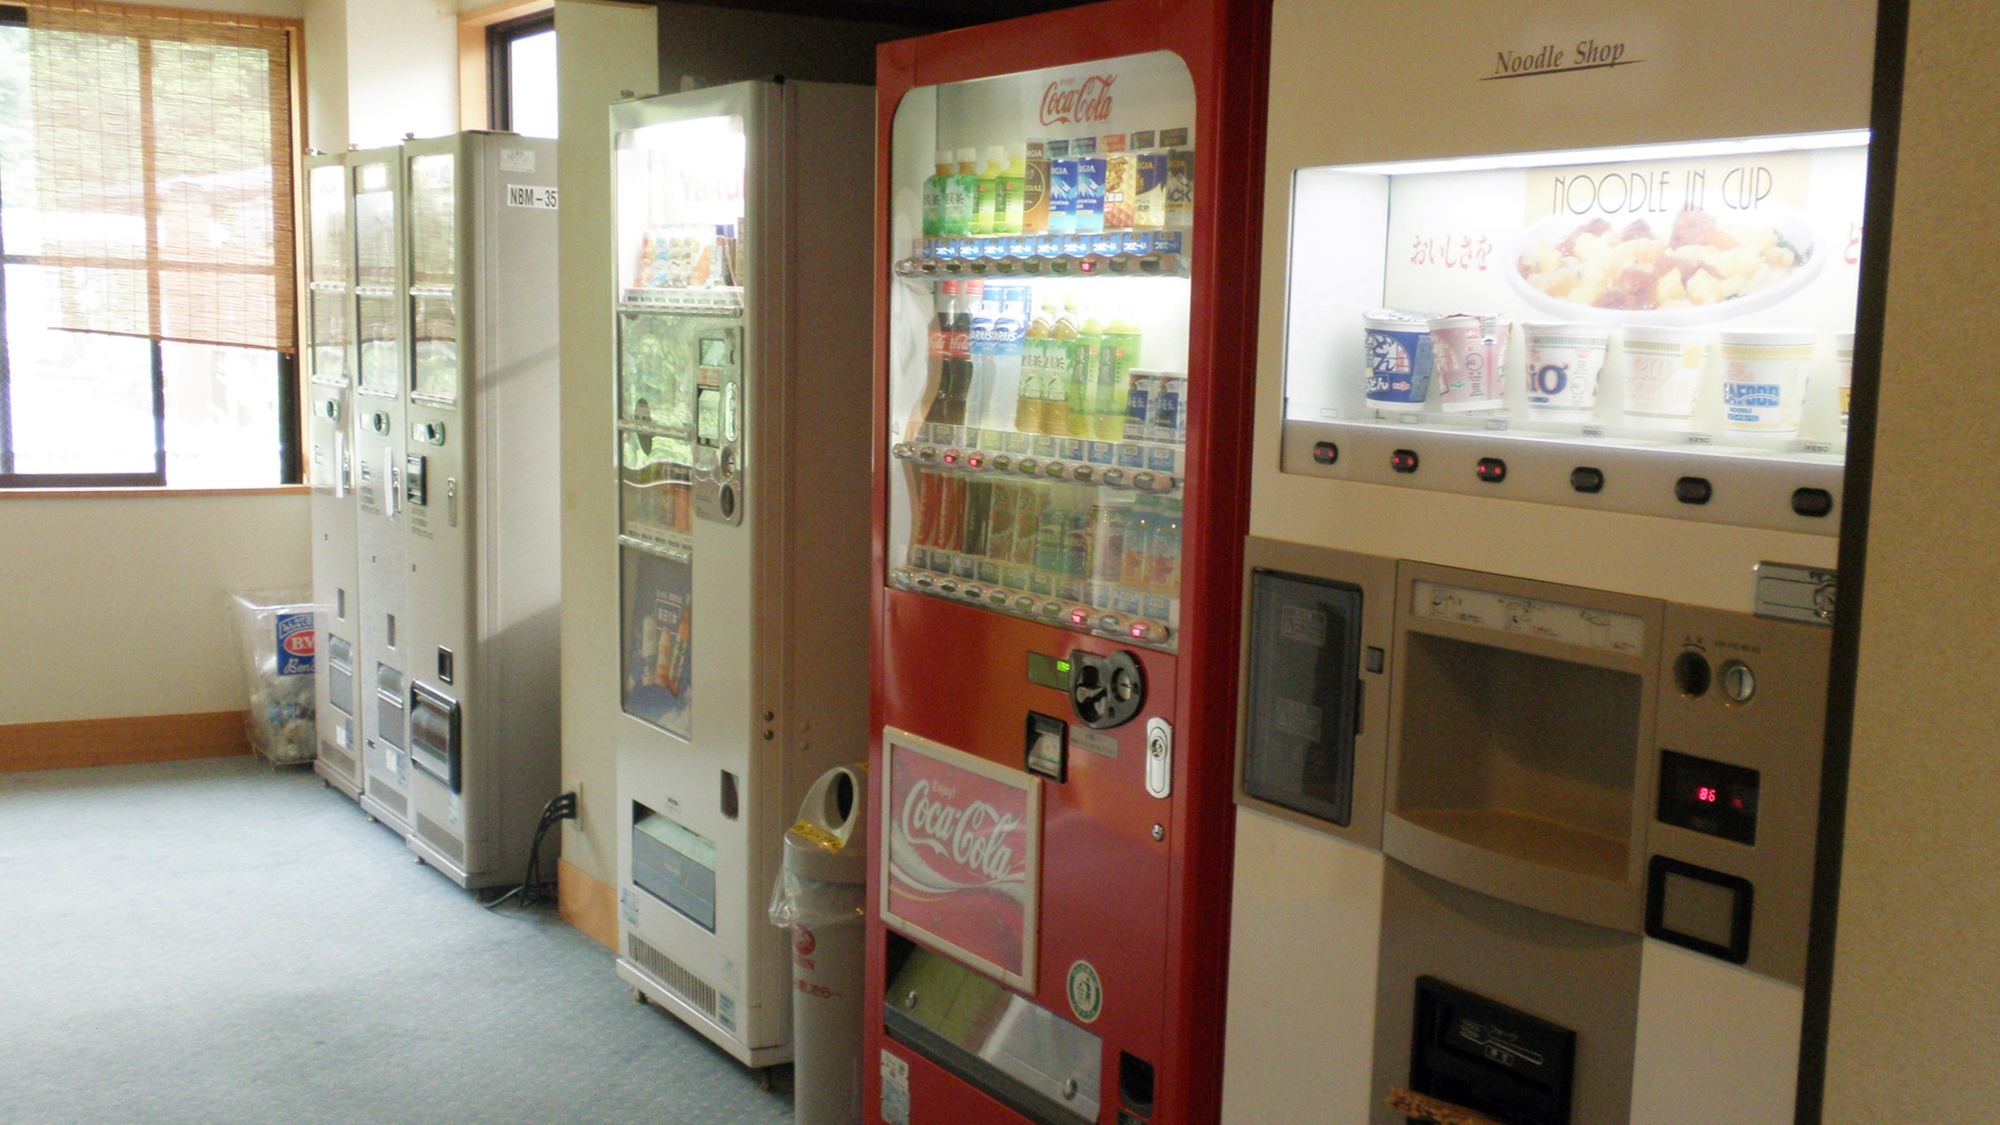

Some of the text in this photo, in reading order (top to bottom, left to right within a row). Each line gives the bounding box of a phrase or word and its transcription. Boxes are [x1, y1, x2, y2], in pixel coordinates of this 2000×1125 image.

[1494, 38, 1625, 75] Noodle Shop
[1040, 74, 1119, 127] Coca-Cola
[510, 187, 560, 207] NBM-35
[677, 170, 745, 203] Yaku
[1552, 166, 1773, 215] NOODLE IN CUP
[1410, 233, 1493, 271] おいしさを
[902, 778, 1019, 880] Coca-Cola
